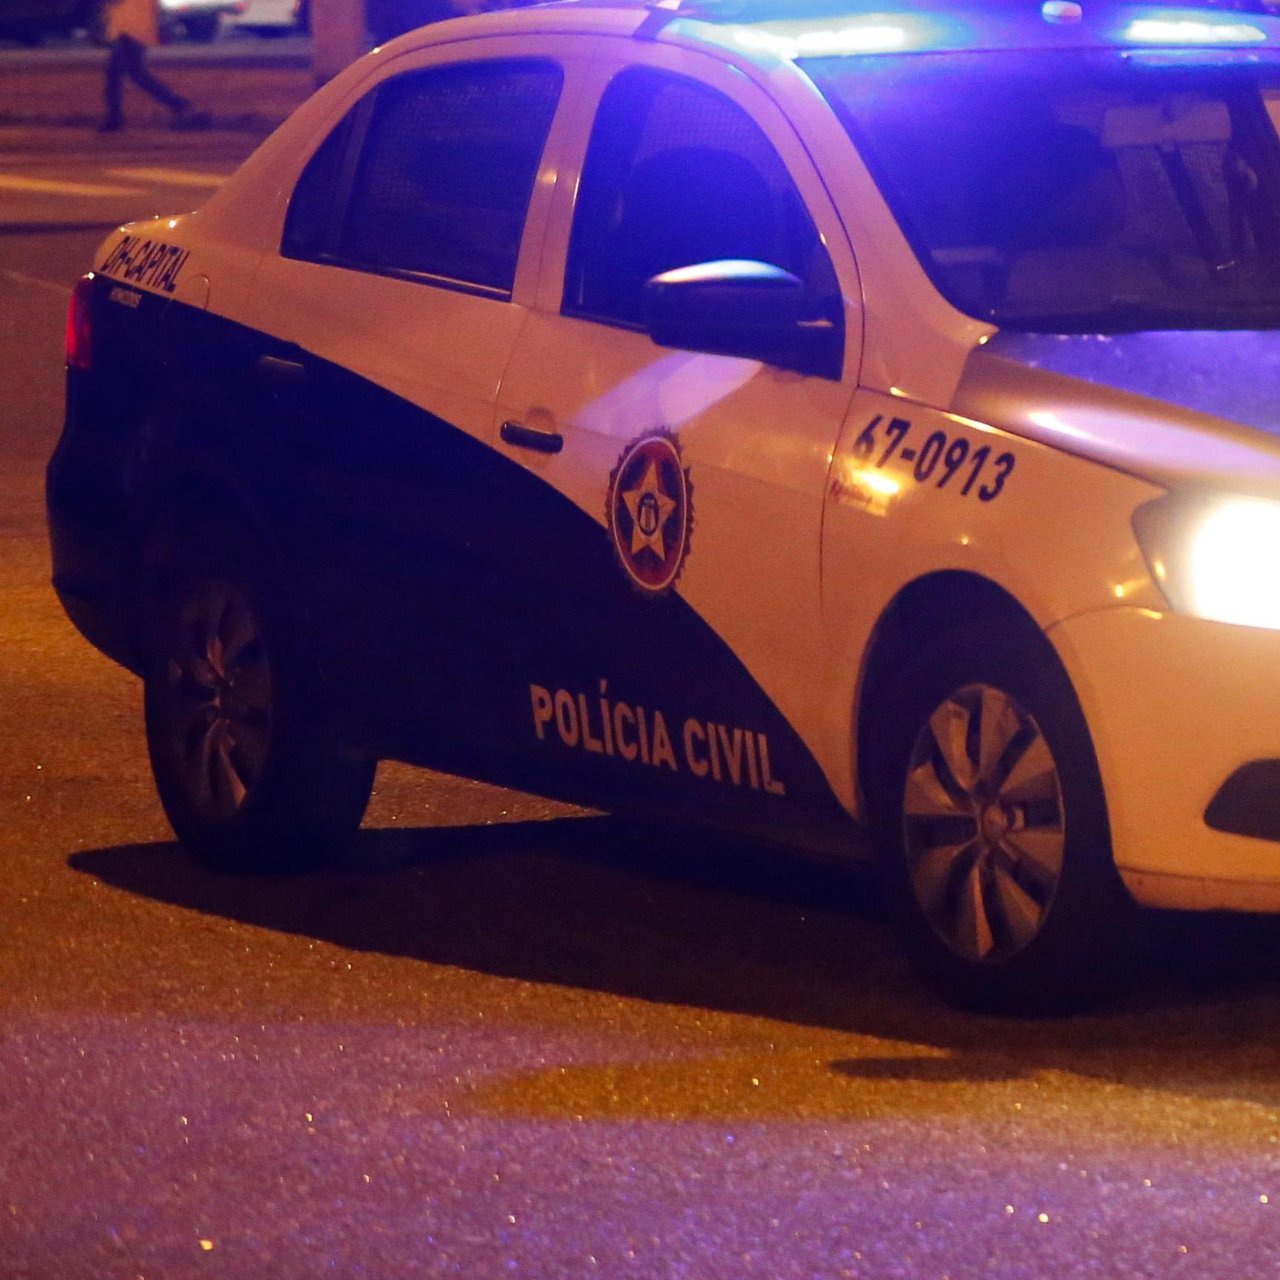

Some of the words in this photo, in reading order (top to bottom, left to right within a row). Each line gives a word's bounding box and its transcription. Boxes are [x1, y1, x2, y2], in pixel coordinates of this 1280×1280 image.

[101, 235, 191, 293] DH-CAPITAL
[853, 413, 1015, 502] 67-0913
[529, 678, 678, 771] POLÍCIA
[683, 718, 786, 796] CIVIL
